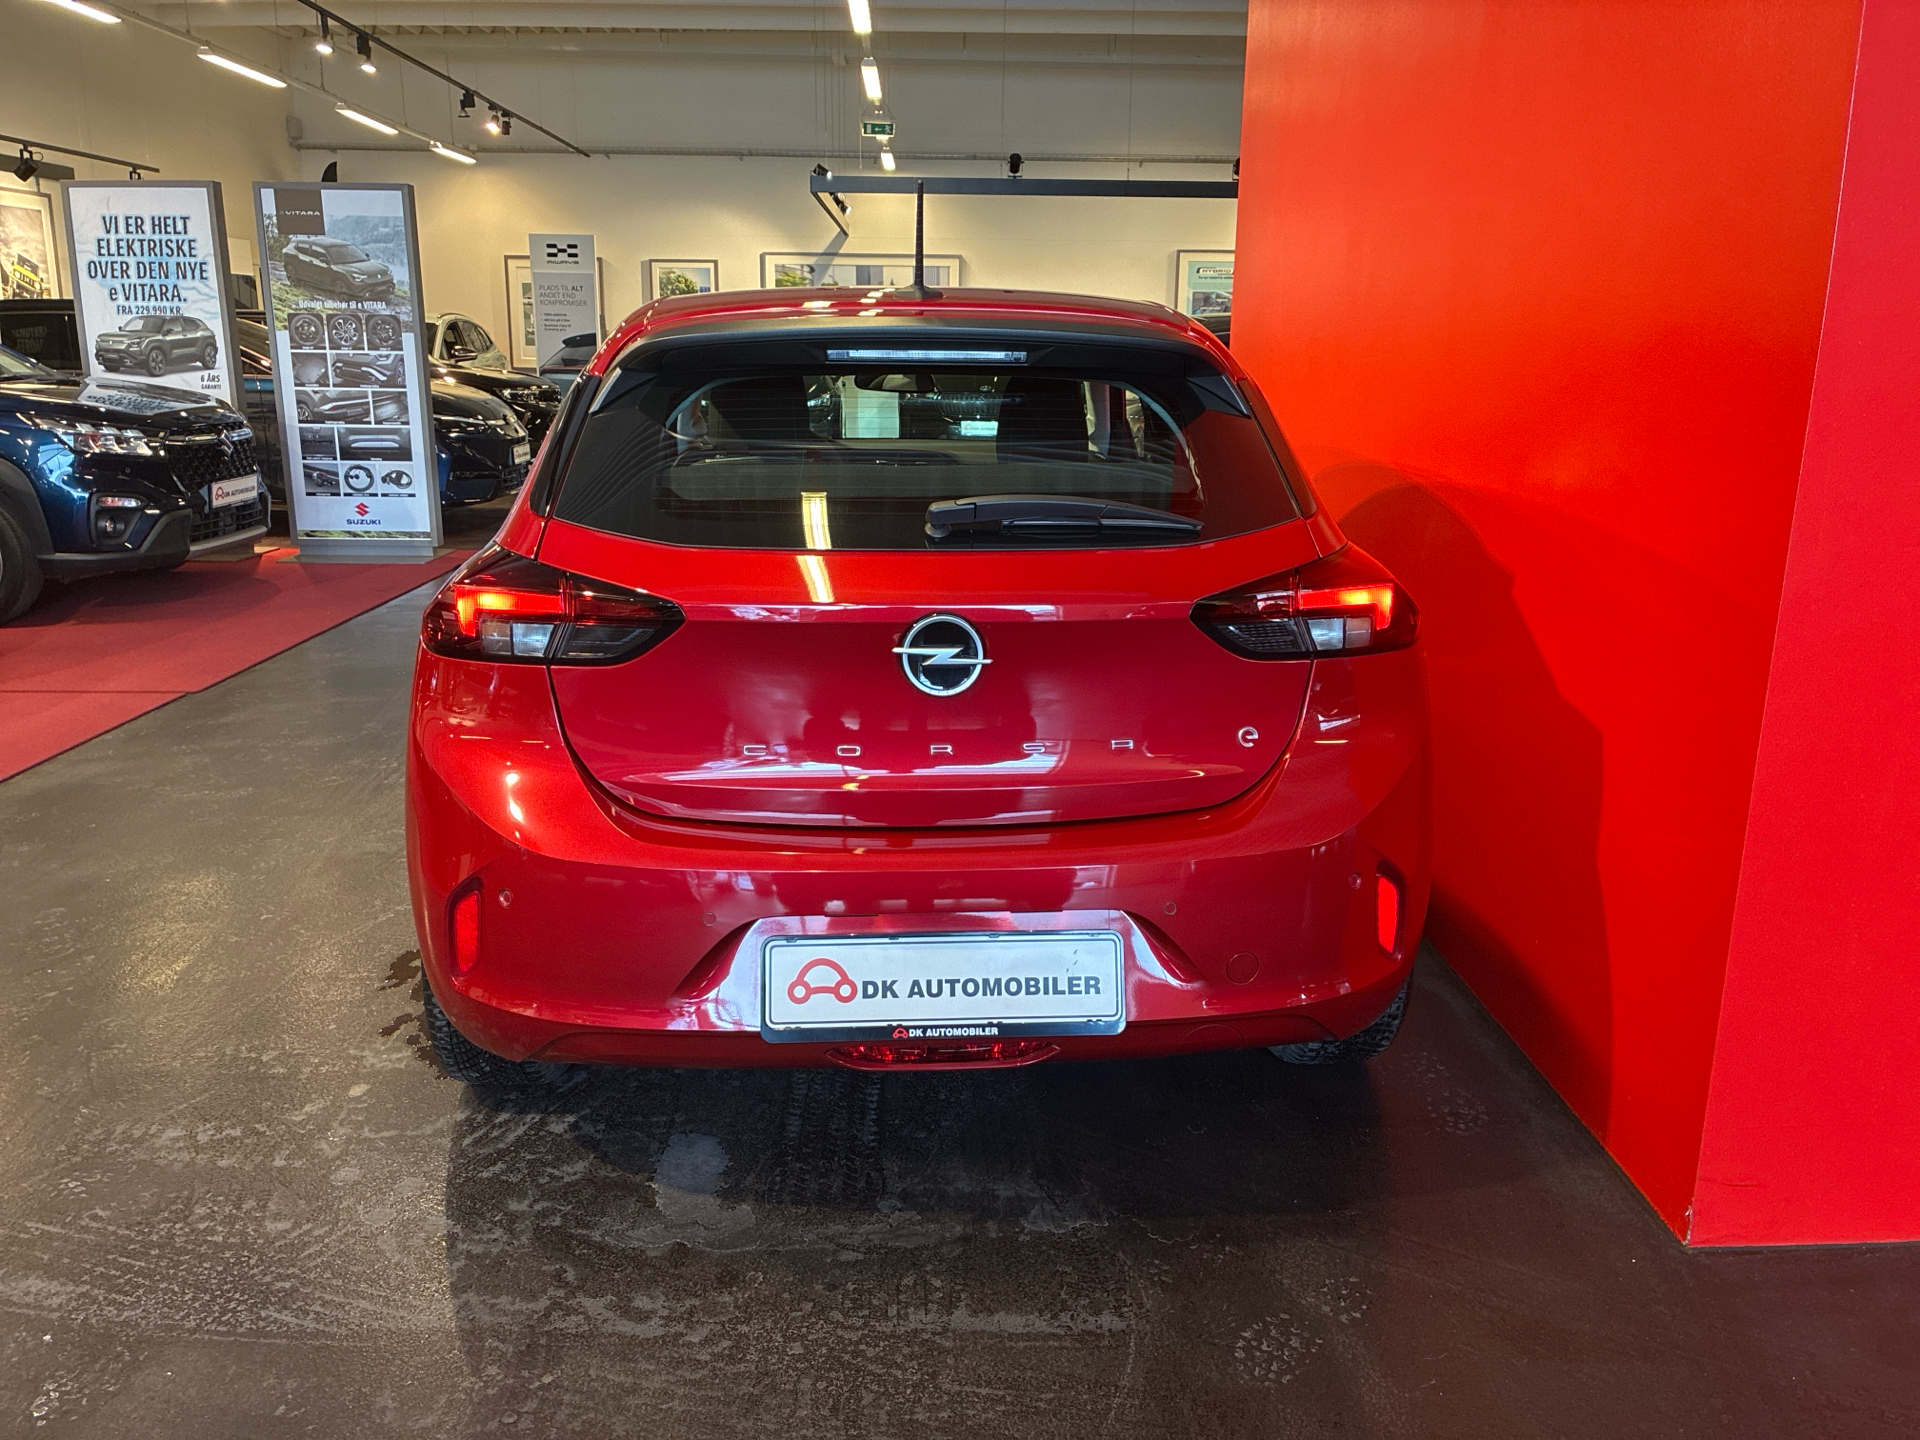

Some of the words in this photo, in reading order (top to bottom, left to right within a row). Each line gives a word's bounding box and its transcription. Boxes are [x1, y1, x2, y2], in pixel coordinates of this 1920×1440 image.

[102, 216, 118, 234] VI
[125, 216, 145, 234] ER
[151, 216, 190, 235] HELT
[96, 238, 197, 257] ELEKTRISKE
[87, 260, 130, 279] OVER
[136, 261, 169, 280] DEN
[176, 262, 208, 280] NYE
[109, 286, 118, 301] e
[121, 283, 187, 303] VITARA.
[116, 306, 133, 315] FRA
[135, 306, 167, 315] 229.990
[169, 306, 184, 316] KR.
[299, 300, 323, 310] Udvalgt
[324, 300, 348, 310] tilbehør
[349, 301, 357, 309] til
[362, 301, 387, 310] VITARA
[200, 374, 204, 382] 6
[206, 372, 220, 383] ÅRS
[742, 738, 1134, 757] CORSA
[1237, 726, 1258, 747] e
[861, 979, 900, 999] DK
[907, 975, 1101, 999] AUTOMOBILER
[908, 1028, 924, 1038] DK
[925, 1026, 998, 1038] AUTOMOBILER
